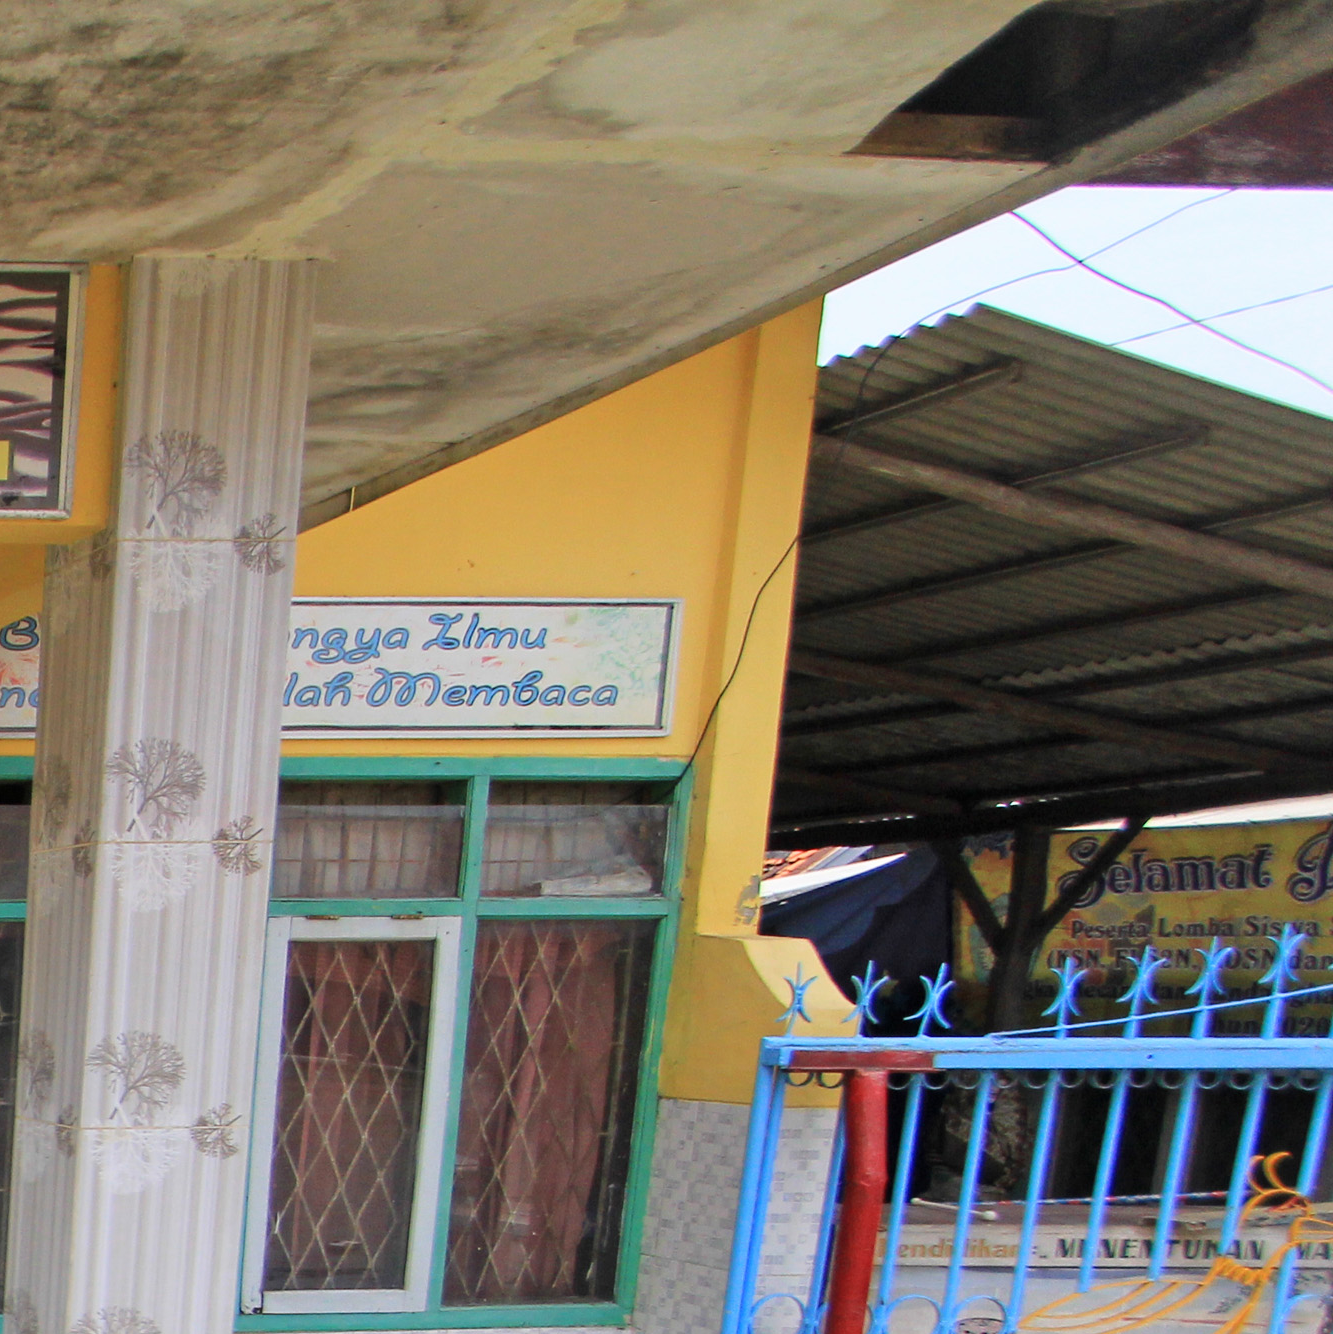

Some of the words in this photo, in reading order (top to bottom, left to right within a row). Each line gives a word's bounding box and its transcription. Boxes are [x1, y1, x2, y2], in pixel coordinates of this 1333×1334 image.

[287, 626, 411, 664] ngya
[421, 602, 548, 650] Ilmu
[281, 671, 354, 707] lah
[365, 667, 620, 707] Membaca
[1056, 836, 1275, 909] Selamat
[1071, 918, 1151, 940] Peserta
[1157, 917, 1235, 938] Lomba
